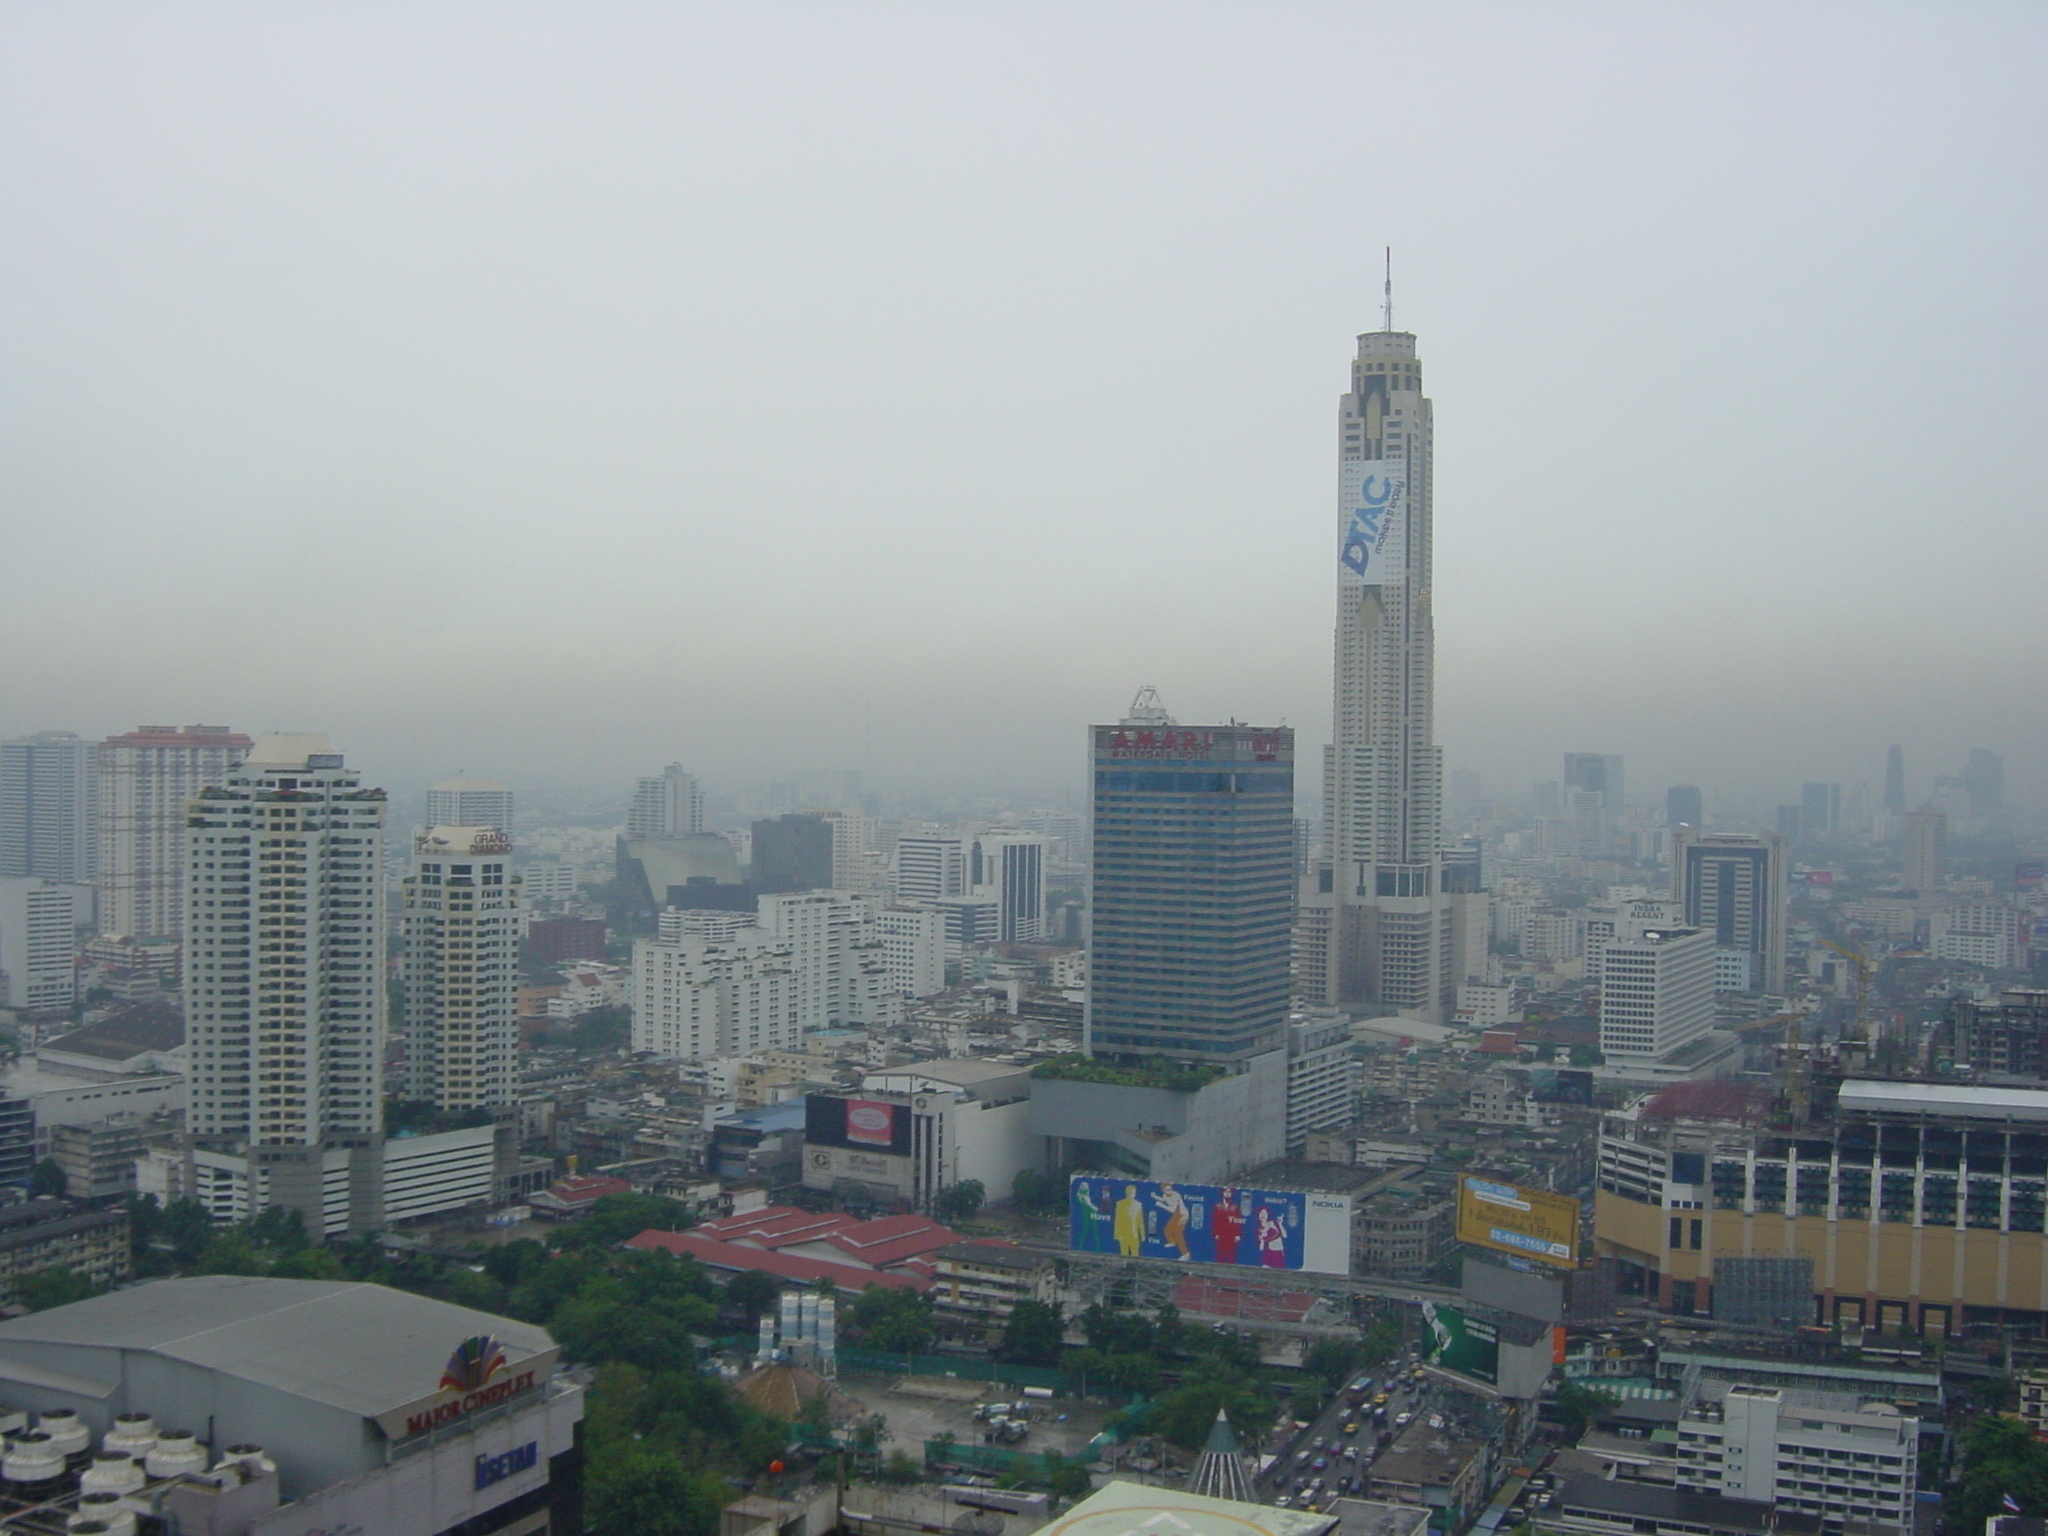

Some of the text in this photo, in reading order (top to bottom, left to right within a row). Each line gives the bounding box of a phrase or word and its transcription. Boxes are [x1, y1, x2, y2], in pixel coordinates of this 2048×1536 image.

[1341, 475, 1391, 577] DTAC
[1112, 730, 1212, 750] AMARI
[1112, 751, 1210, 760] WATERGATE HOTEL
[475, 834, 507, 844] GRAND
[470, 844, 512, 856] DIAMOND
[1630, 911, 1664, 919] REGENT
[407, 1370, 535, 1435] MAJOR CINEPLEX
